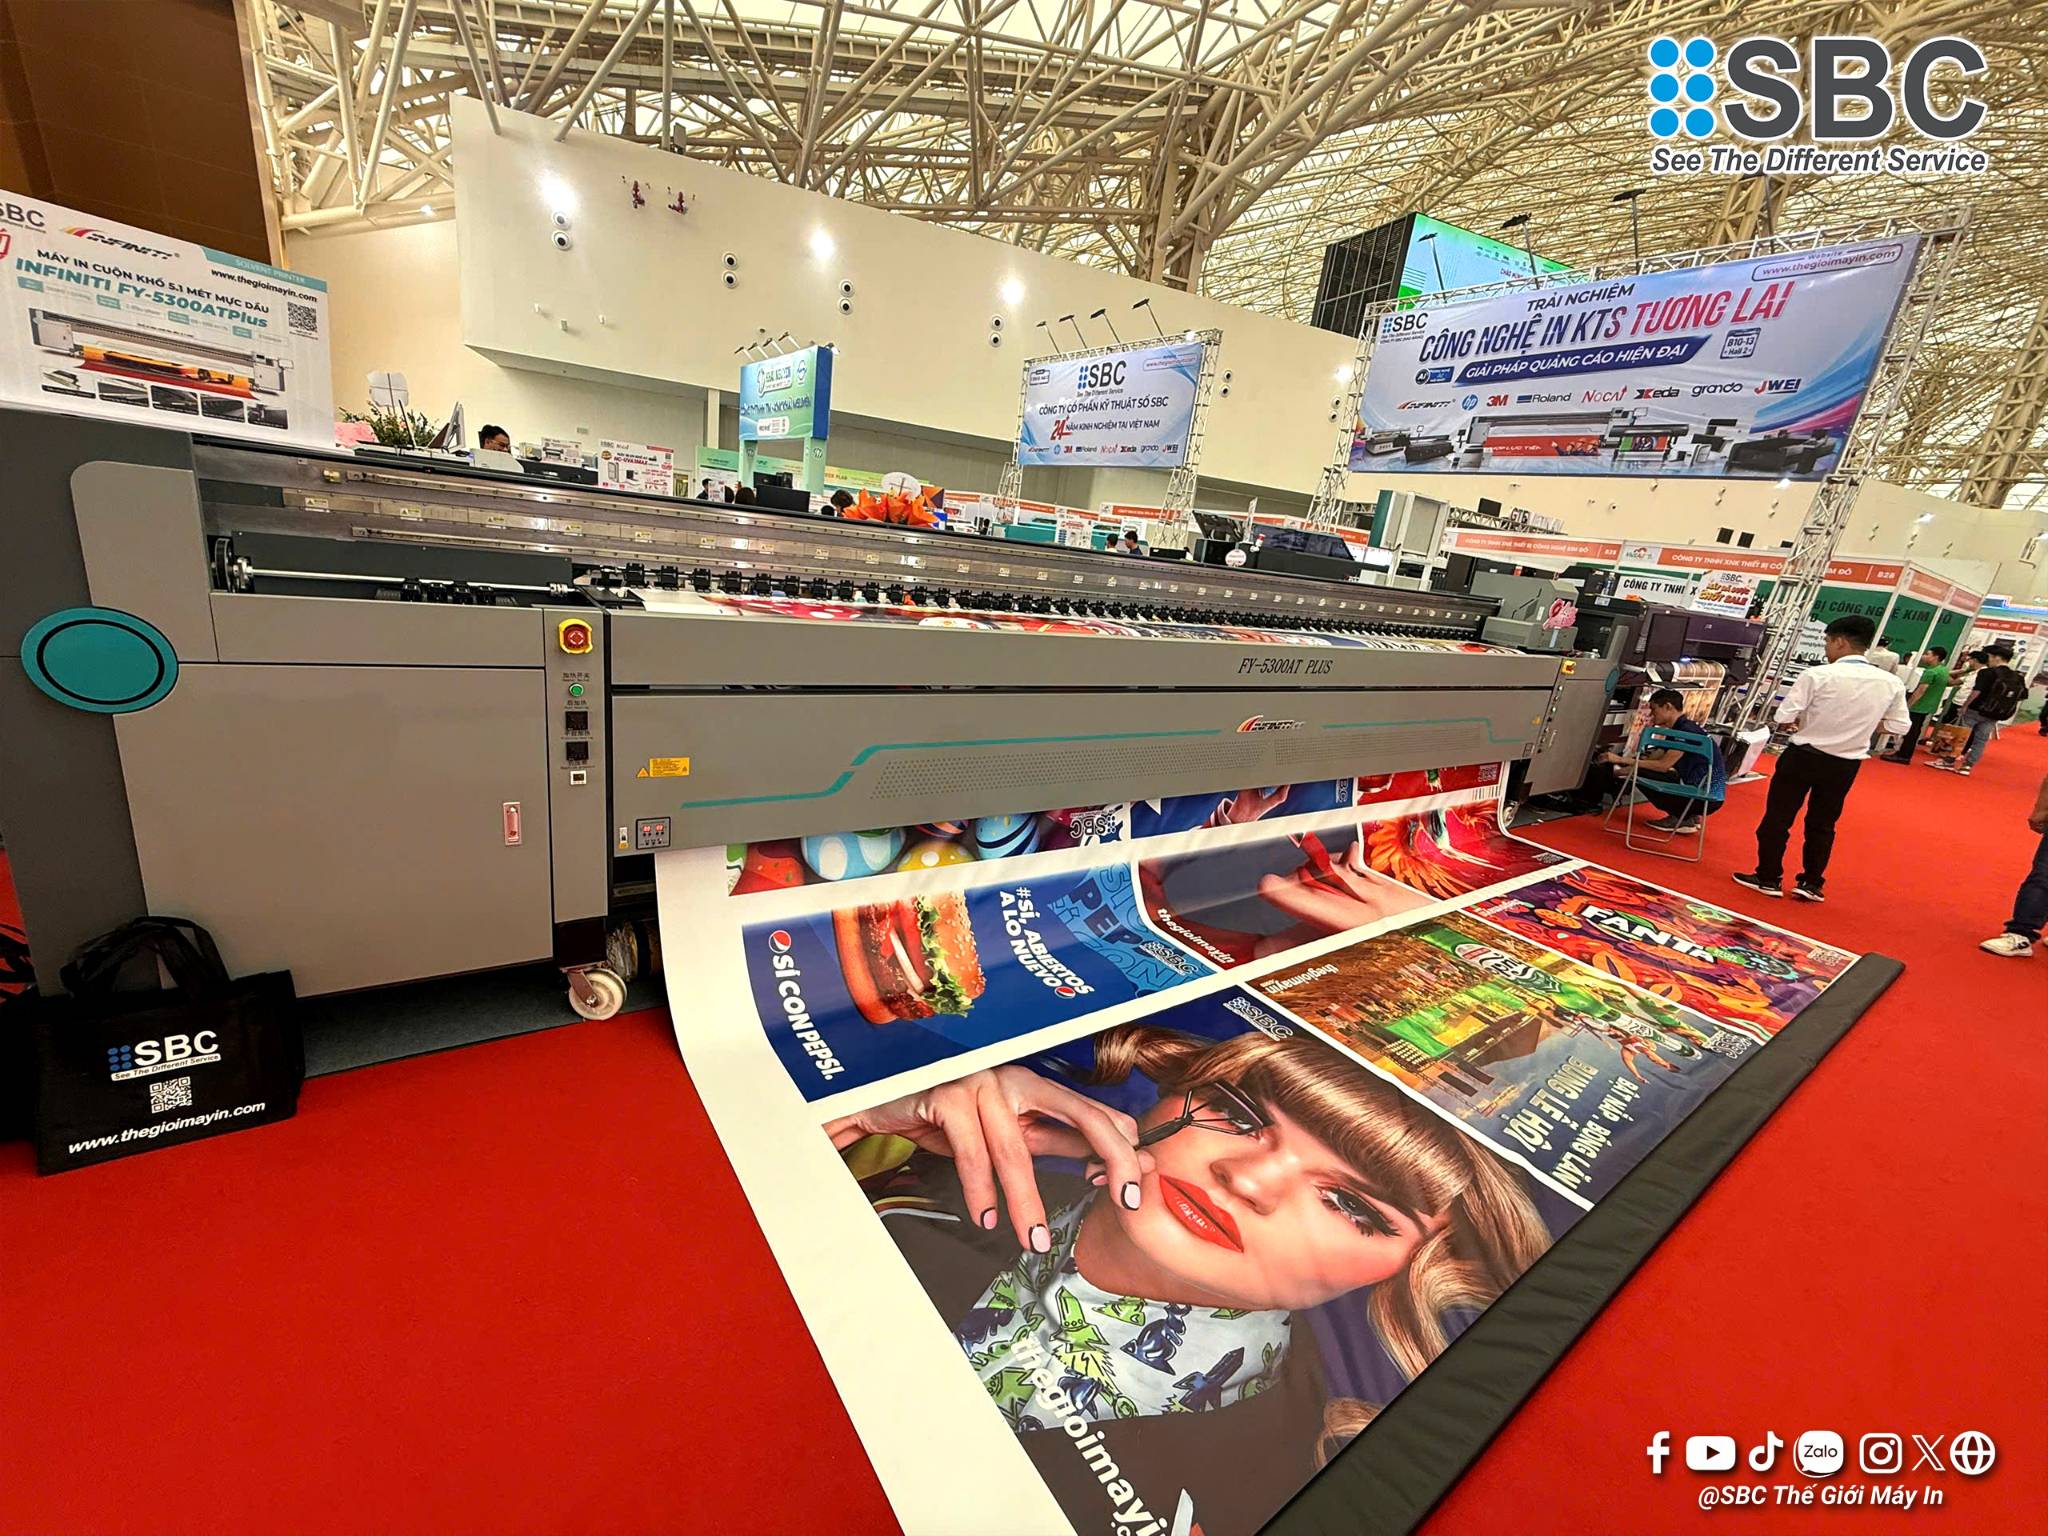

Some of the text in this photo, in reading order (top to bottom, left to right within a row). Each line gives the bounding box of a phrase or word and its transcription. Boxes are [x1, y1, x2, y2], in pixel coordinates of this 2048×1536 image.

[0, 201, 45, 228] BC
[74, 258, 89, 269] IN
[168, 282, 184, 294] 5.1
[1762, 250, 1896, 276] www.thegioimayin.com
[16, 257, 111, 292] INFINITI
[118, 282, 268, 328] FY-5300ATPlus
[211, 269, 318, 303] www.thegioimayin.com
[1527, 283, 1635, 312] TRẢI NGHIỆM
[1392, 313, 1428, 332] SBC
[1419, 280, 1796, 363] CÔNG NGHỆ IN KTS TƯƠNG LAI
[1727, 335, 1755, 348] B10-13
[1728, 347, 1741, 356] Hall
[1088, 360, 1126, 388] SBC
[1466, 360, 1489, 379] GIẢI
[1491, 357, 1528, 376] PHÁP
[1529, 352, 1581, 374] QUẢNG
[1581, 349, 1614, 367] CÁO
[1613, 341, 1654, 364] HIỆN
[1655, 342, 1689, 360] ĐẠI
[1058, 404, 1066, 414] TY
[1150, 396, 1169, 408] SBC
[1487, 395, 1509, 407] 3M
[1532, 392, 1572, 403] Roland
[1754, 378, 1801, 395] JWEI
[1143, 419, 1160, 428] NAM
[1671, 553, 1693, 563] CÔNG
[1623, 578, 1649, 591] CÔNG
[1650, 582, 1662, 592] TY
[1725, 573, 1742, 583] SBC
[1238, 658, 1333, 674] FY-5300AT PLUS
[1070, 815, 1107, 838] SBC
[1000, 890, 1063, 987] A LO NUEVO
[1582, 904, 1715, 964] FANTA
[1024, 929, 1095, 994] ABIERTOS
[778, 980, 814, 1031] CON
[1243, 1005, 1293, 1039] SBC
[134, 1030, 219, 1066] SBC
[114, 1054, 219, 1080] See The Different Service
[1608, 1076, 1640, 1103] BẬT
[68, 1101, 267, 1154] www.thegioimayin.com
[1500, 1108, 1553, 1153] HỘI
[1571, 1119, 1613, 1159] BÓNG
[1010, 1331, 1169, 1536] thegioimayi
